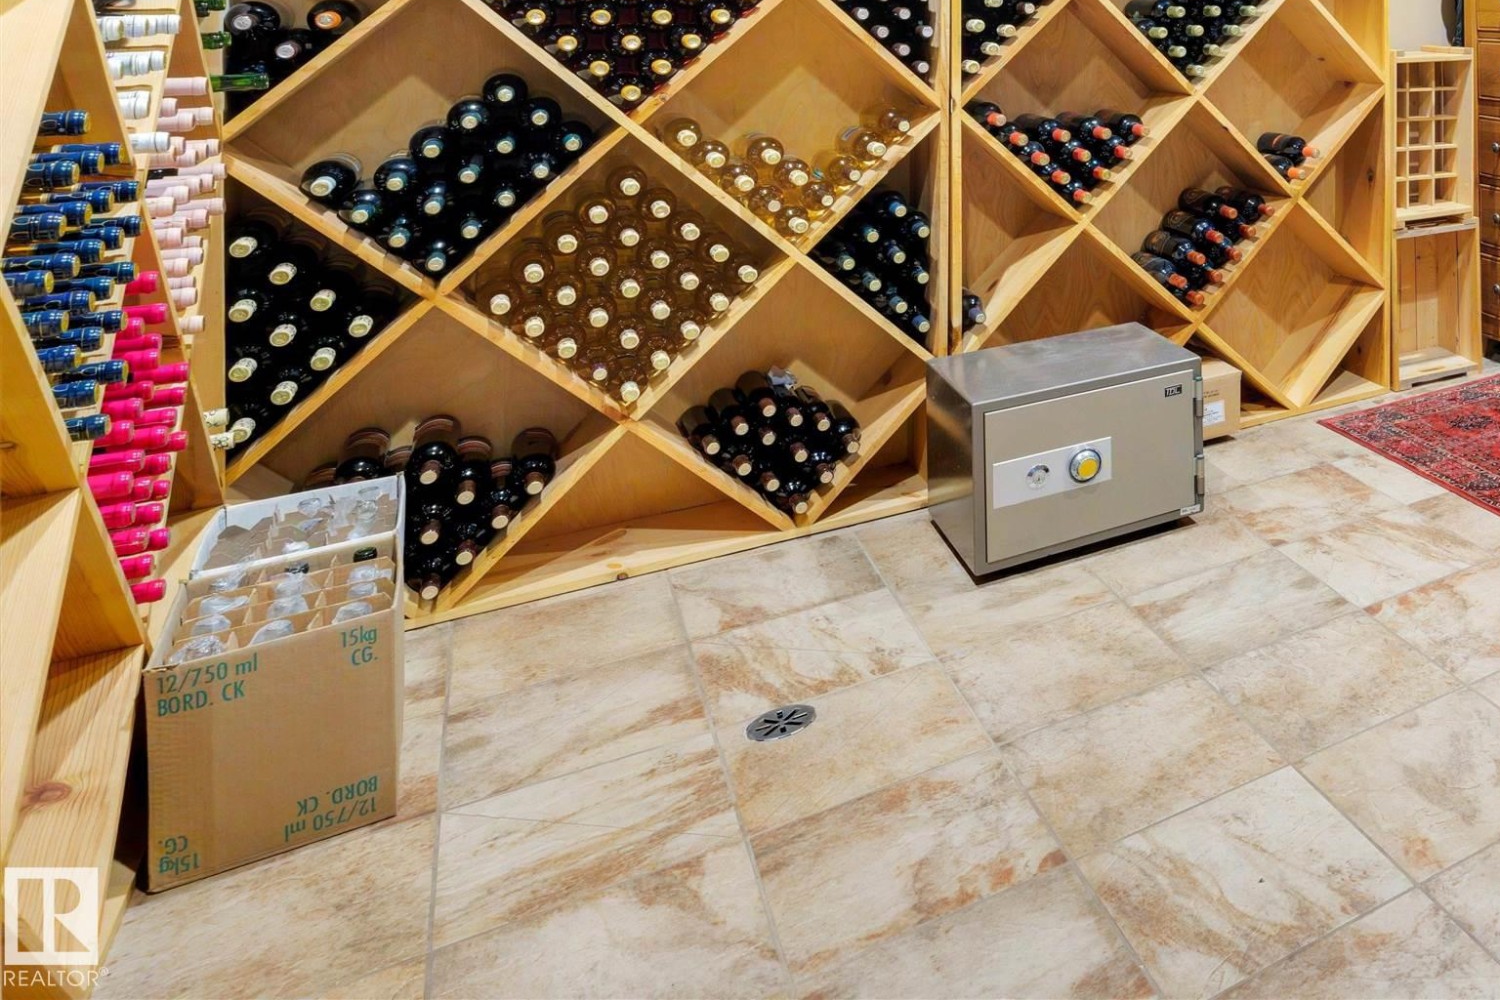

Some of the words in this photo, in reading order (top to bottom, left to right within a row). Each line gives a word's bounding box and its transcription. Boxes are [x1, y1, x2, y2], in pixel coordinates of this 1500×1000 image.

[341, 625, 377, 648] 15kg
[351, 647, 378, 666] CG.
[156, 662, 228, 694] 12/750
[235, 653, 258, 676] ml
[157, 690, 214, 717] BORD.
[222, 680, 247, 701] CK
[326, 775, 378, 799] BORD.
[297, 796, 319, 816] CK
[313, 797, 376, 831] 12/750
[284, 818, 306, 842] ml
[158, 835, 188, 855] CG.
[159, 853, 199, 874] 15kg
